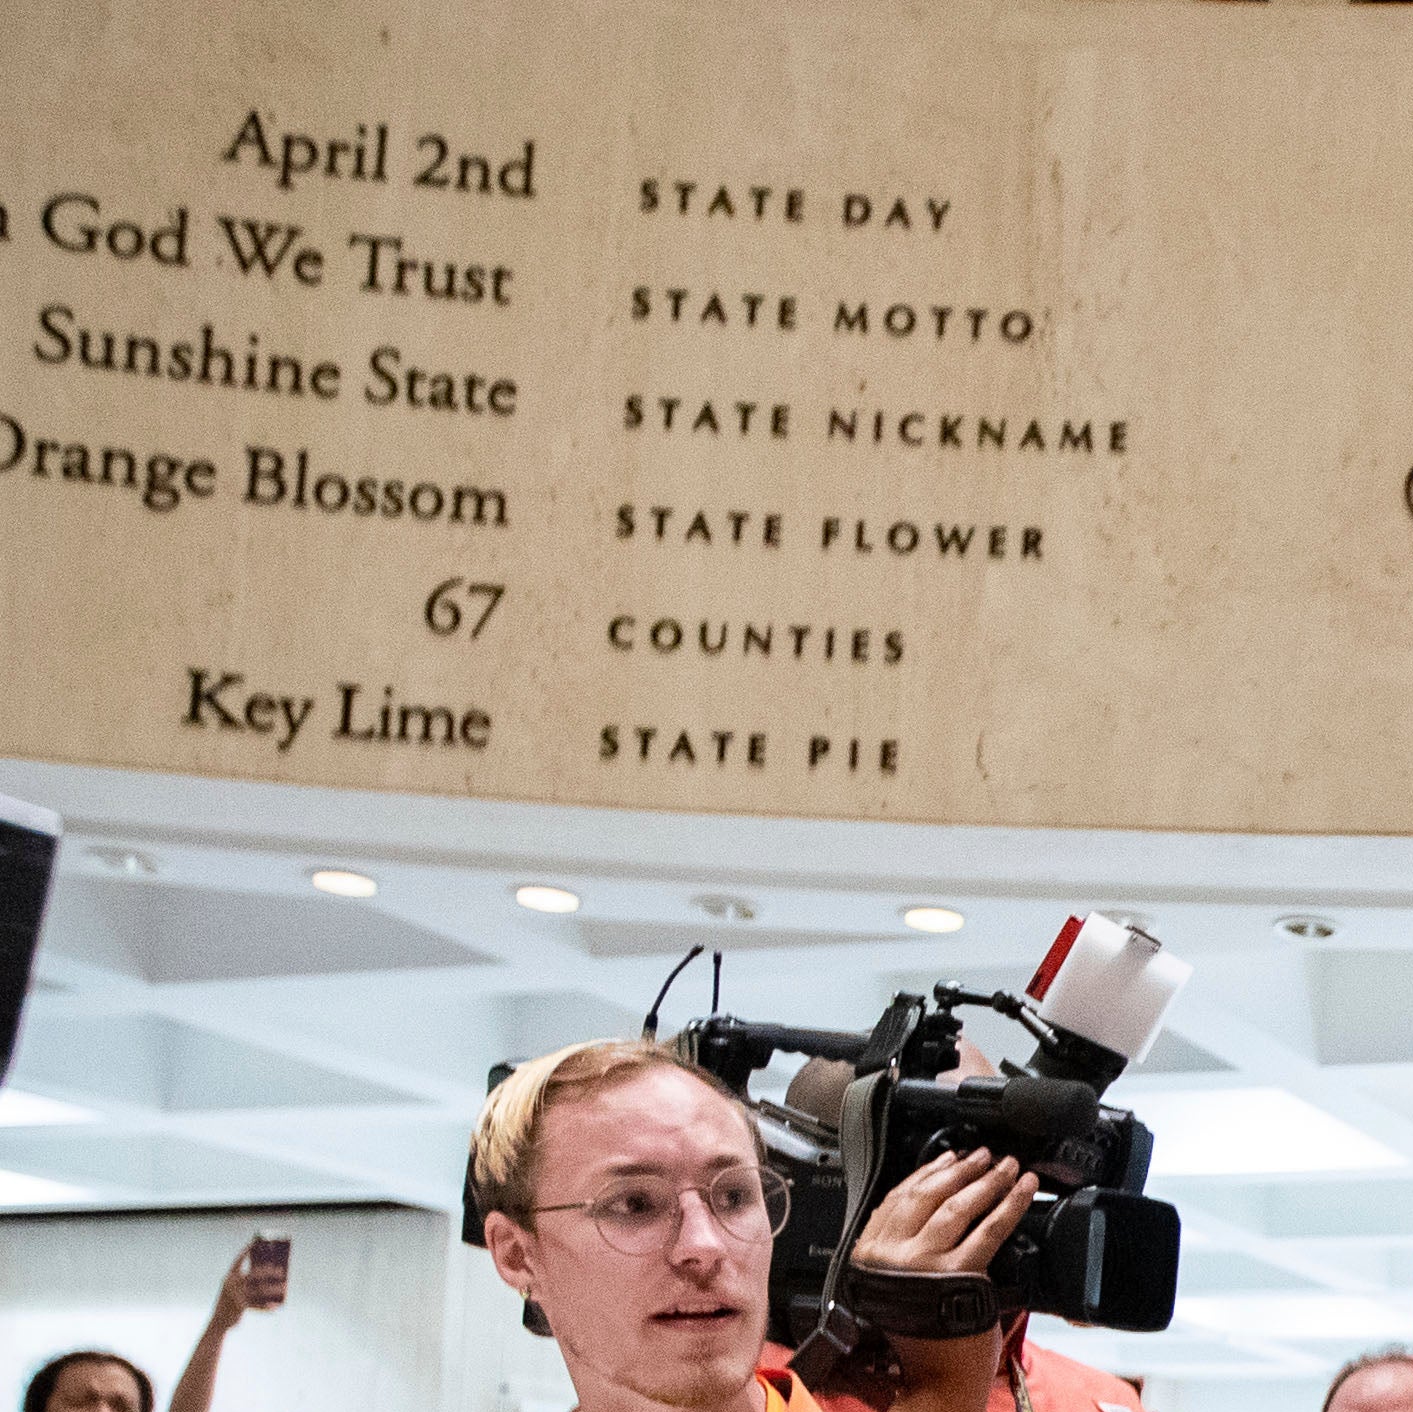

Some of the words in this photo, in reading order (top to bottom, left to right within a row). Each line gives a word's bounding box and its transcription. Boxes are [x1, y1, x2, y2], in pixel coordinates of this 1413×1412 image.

[221, 109, 389, 192] April
[413, 133, 536, 200] 2nd
[640, 178, 804, 224] STATE
[842, 193, 950, 232] DAY
[40, 193, 189, 268] God
[217, 216, 324, 287] We
[348, 233, 513, 307] Trust
[631, 286, 796, 331] STATE
[834, 302, 1035, 346] MOTTO
[33, 304, 341, 400] Sunshine
[364, 346, 518, 418] State
[624, 394, 790, 439] STATE
[827, 409, 1127, 455] NICKNAME
[243, 445, 509, 528] Blossom
[616, 503, 782, 549] STATE
[821, 517, 1044, 561] FLOWER
[423, 577, 506, 640] 67
[607, 615, 904, 666] COUNTIES
[181, 667, 315, 755] Key
[332, 682, 492, 752] Lime
[599, 724, 767, 770] STATE
[807, 735, 898, 777] PIE
